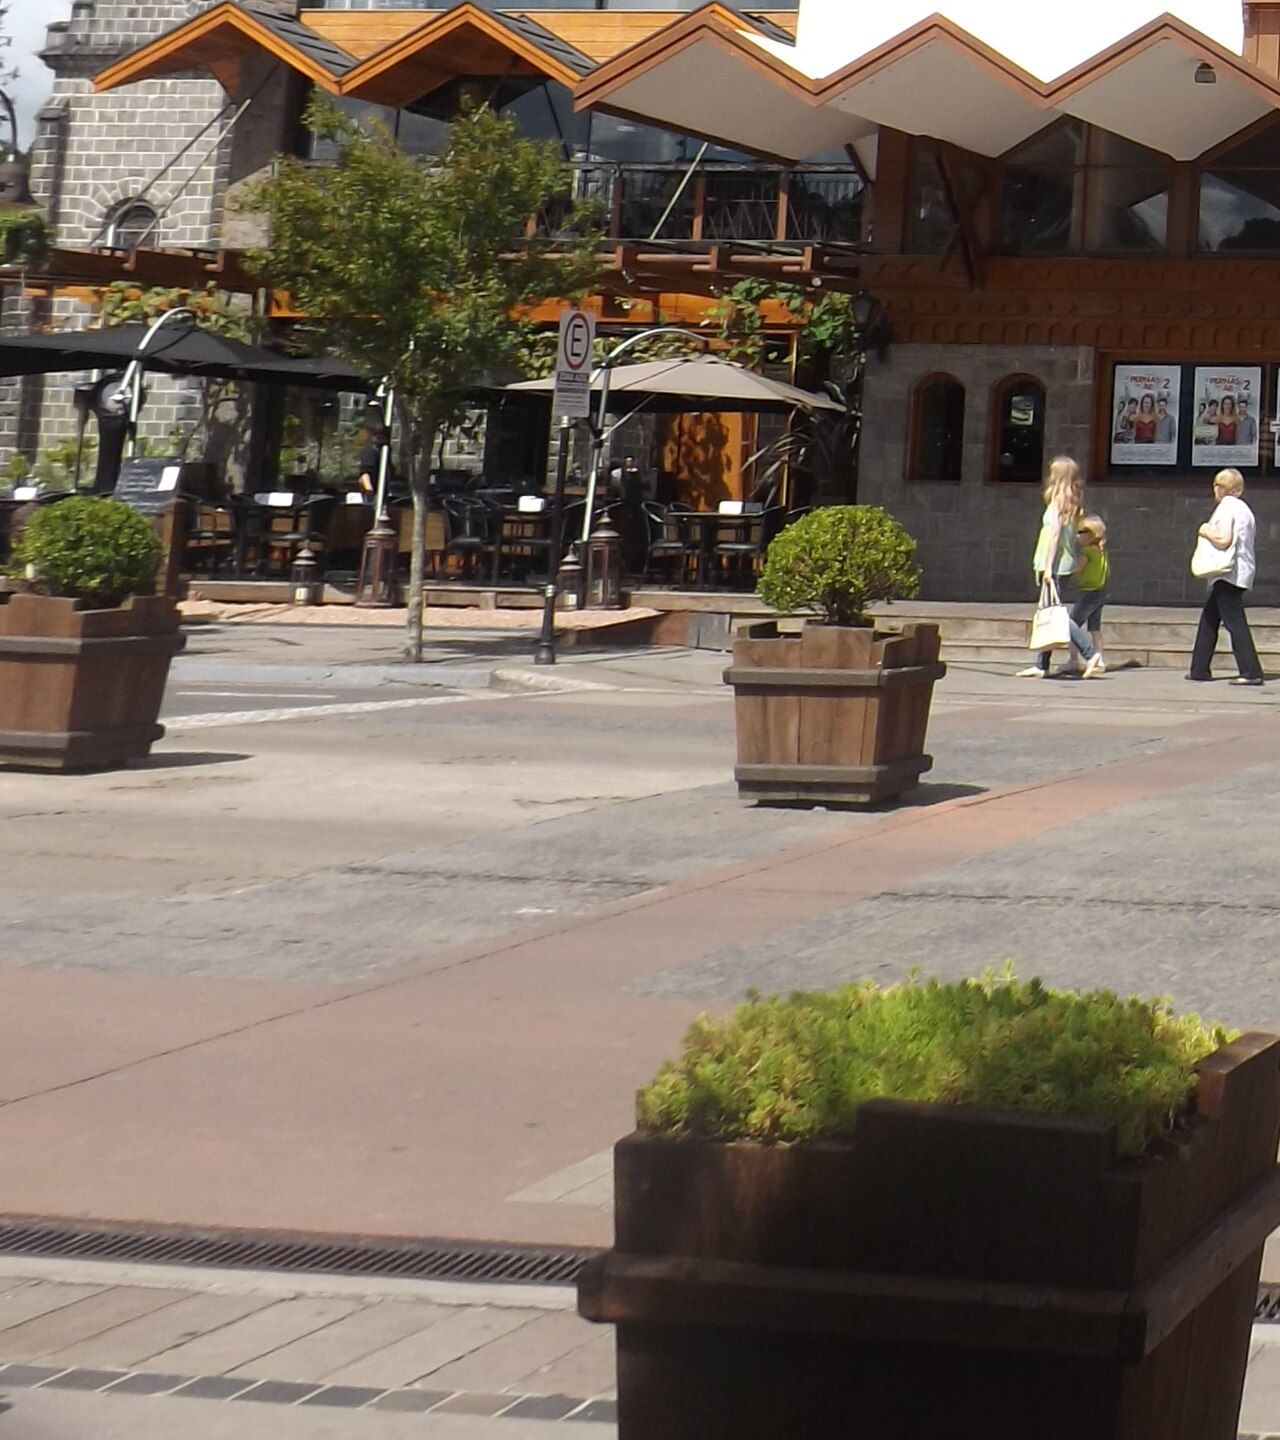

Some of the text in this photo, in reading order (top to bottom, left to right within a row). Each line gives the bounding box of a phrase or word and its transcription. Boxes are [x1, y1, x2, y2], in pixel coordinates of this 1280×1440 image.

[571, 324, 583, 357] E
[1162, 378, 1170, 389] 2
[1243, 379, 1251, 391] 2
